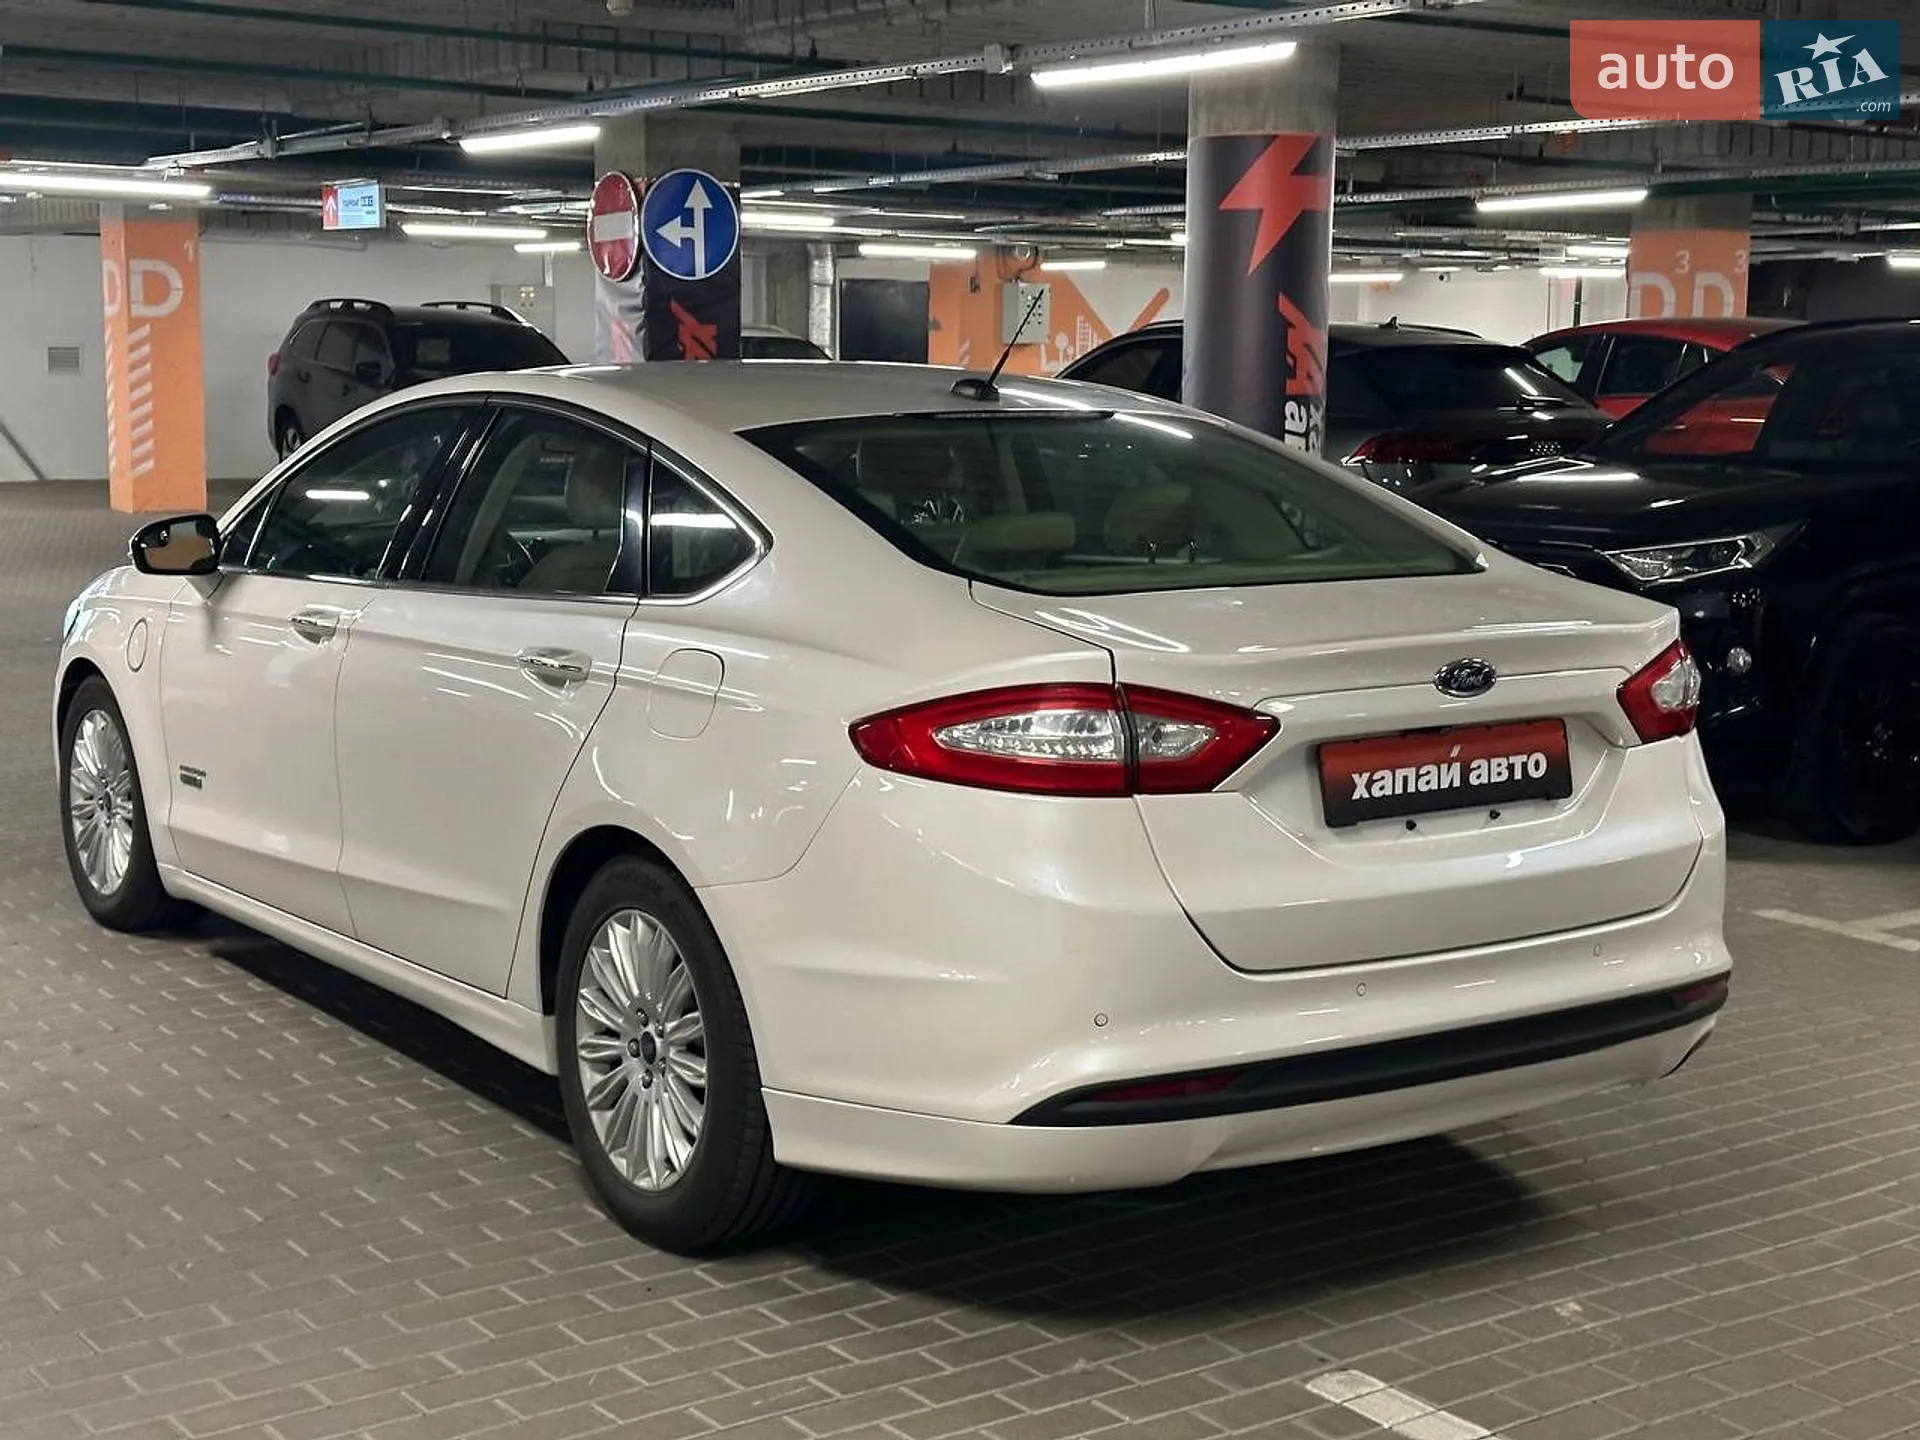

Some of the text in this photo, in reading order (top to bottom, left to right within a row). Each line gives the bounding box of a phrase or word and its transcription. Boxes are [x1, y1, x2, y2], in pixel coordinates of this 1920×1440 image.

[1675, 250, 1690, 274] 3
[1734, 249, 1746, 273] 3
[129, 259, 183, 318] D
[1450, 667, 1489, 689] Ford
[1468, 751, 1548, 785] авто
